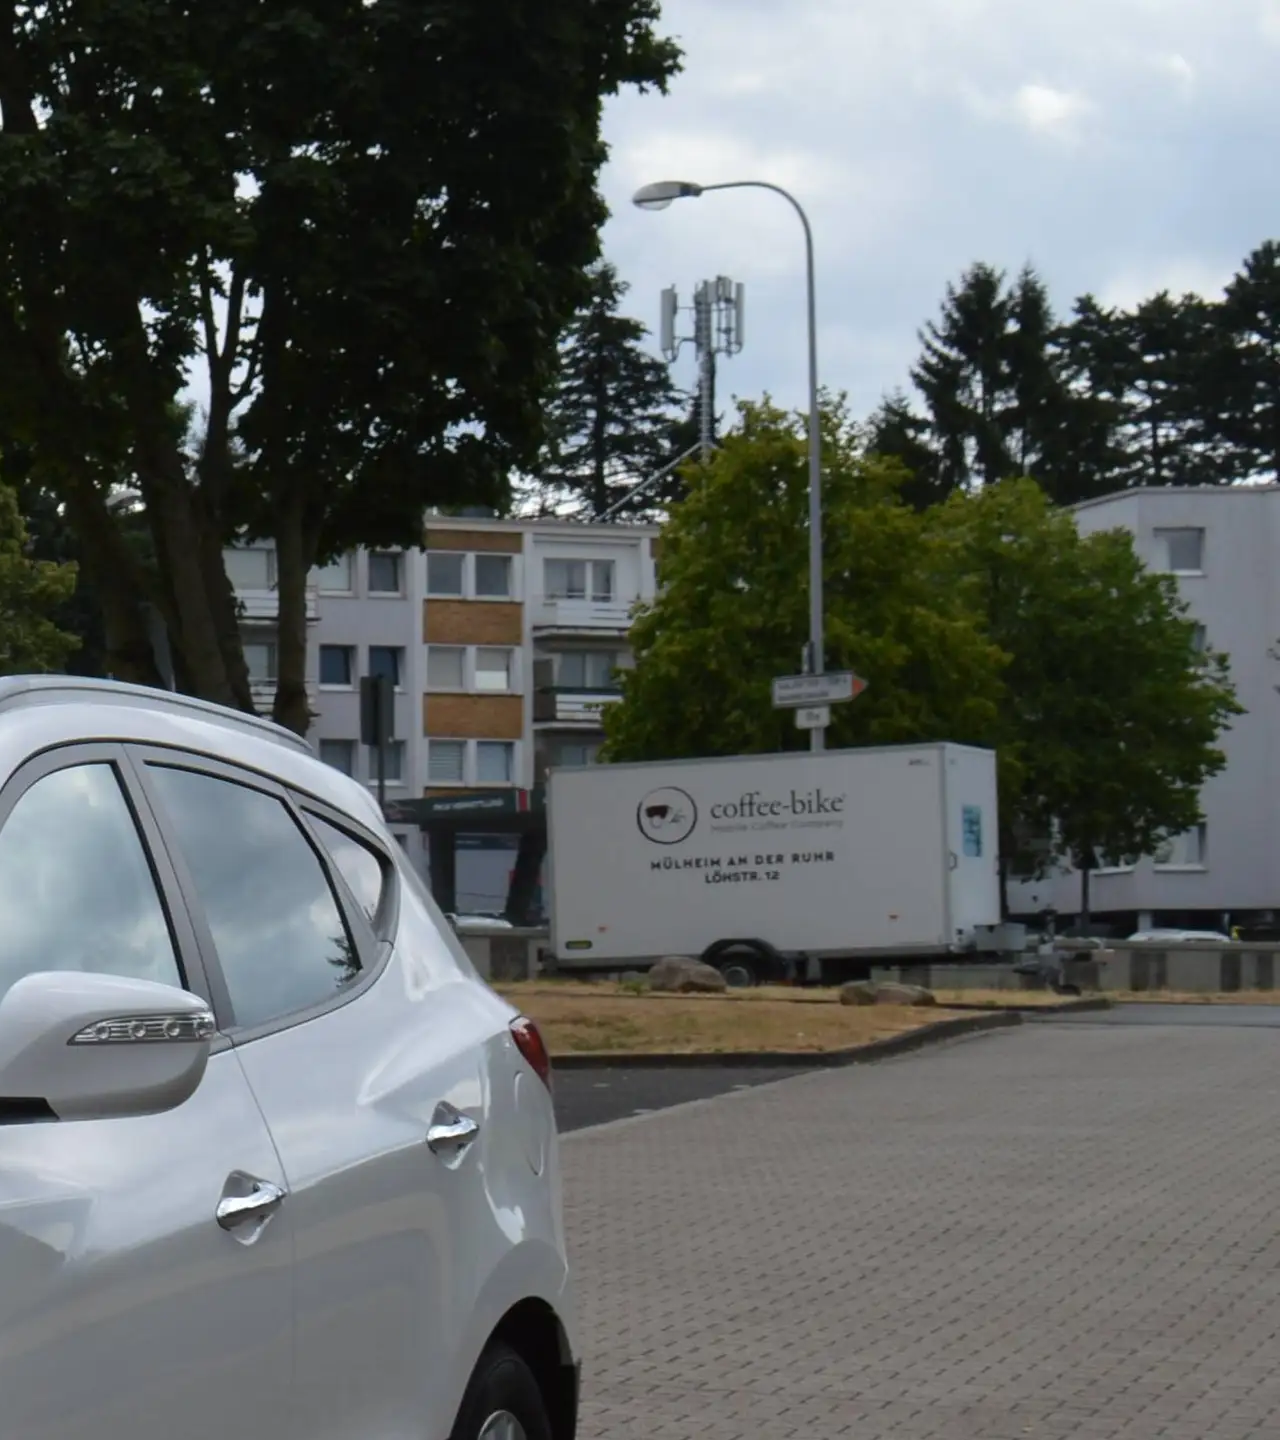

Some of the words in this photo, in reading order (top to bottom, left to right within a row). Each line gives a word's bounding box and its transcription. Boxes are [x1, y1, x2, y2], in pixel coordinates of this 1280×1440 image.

[710, 788, 844, 819] coffee-bike
[650, 856, 721, 871] MÜLHEIM
[727, 855, 748, 867] AN
[754, 853, 784, 866] DER
[791, 851, 835, 864] RUHR
[705, 869, 761, 884] LÖHSTR.
[764, 870, 780, 881] 12
